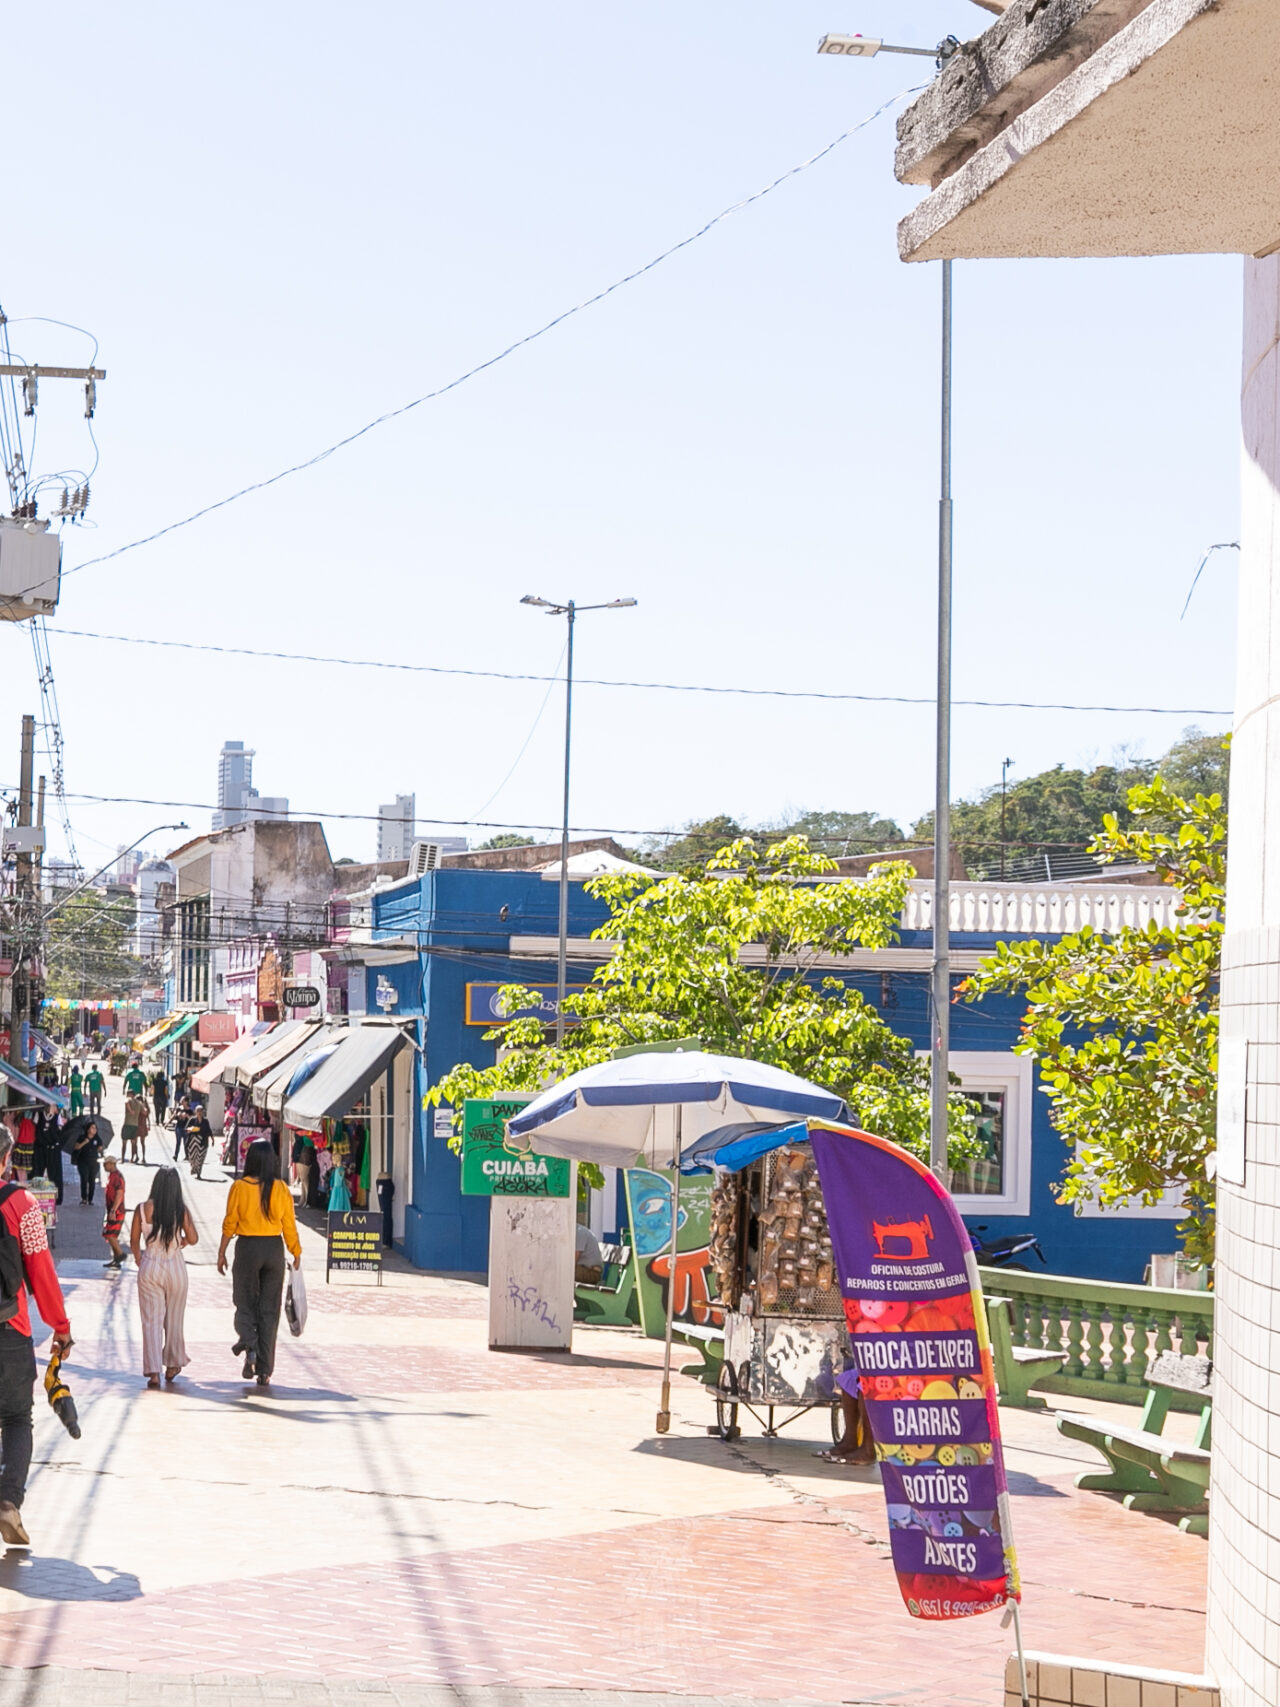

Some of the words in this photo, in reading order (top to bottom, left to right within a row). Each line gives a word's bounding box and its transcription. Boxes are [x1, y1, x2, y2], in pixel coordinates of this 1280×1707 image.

[482, 1158, 549, 1176] CUIABÁ
[871, 1263, 904, 1276] OFICINA
[903, 1265, 913, 1276] DE
[912, 1262, 945, 1276] COSTURA
[846, 1277, 885, 1291] REPAROS
[886, 1280, 892, 1291] E
[893, 1279, 934, 1291] CONCERTOS
[935, 1277, 946, 1288] EM
[946, 1272, 968, 1287] GERAL
[854, 1340, 914, 1370] TROCA
[914, 1339, 935, 1368] DE
[892, 1406, 962, 1436] BARRAS
[901, 1468, 970, 1505] BOTÕES
